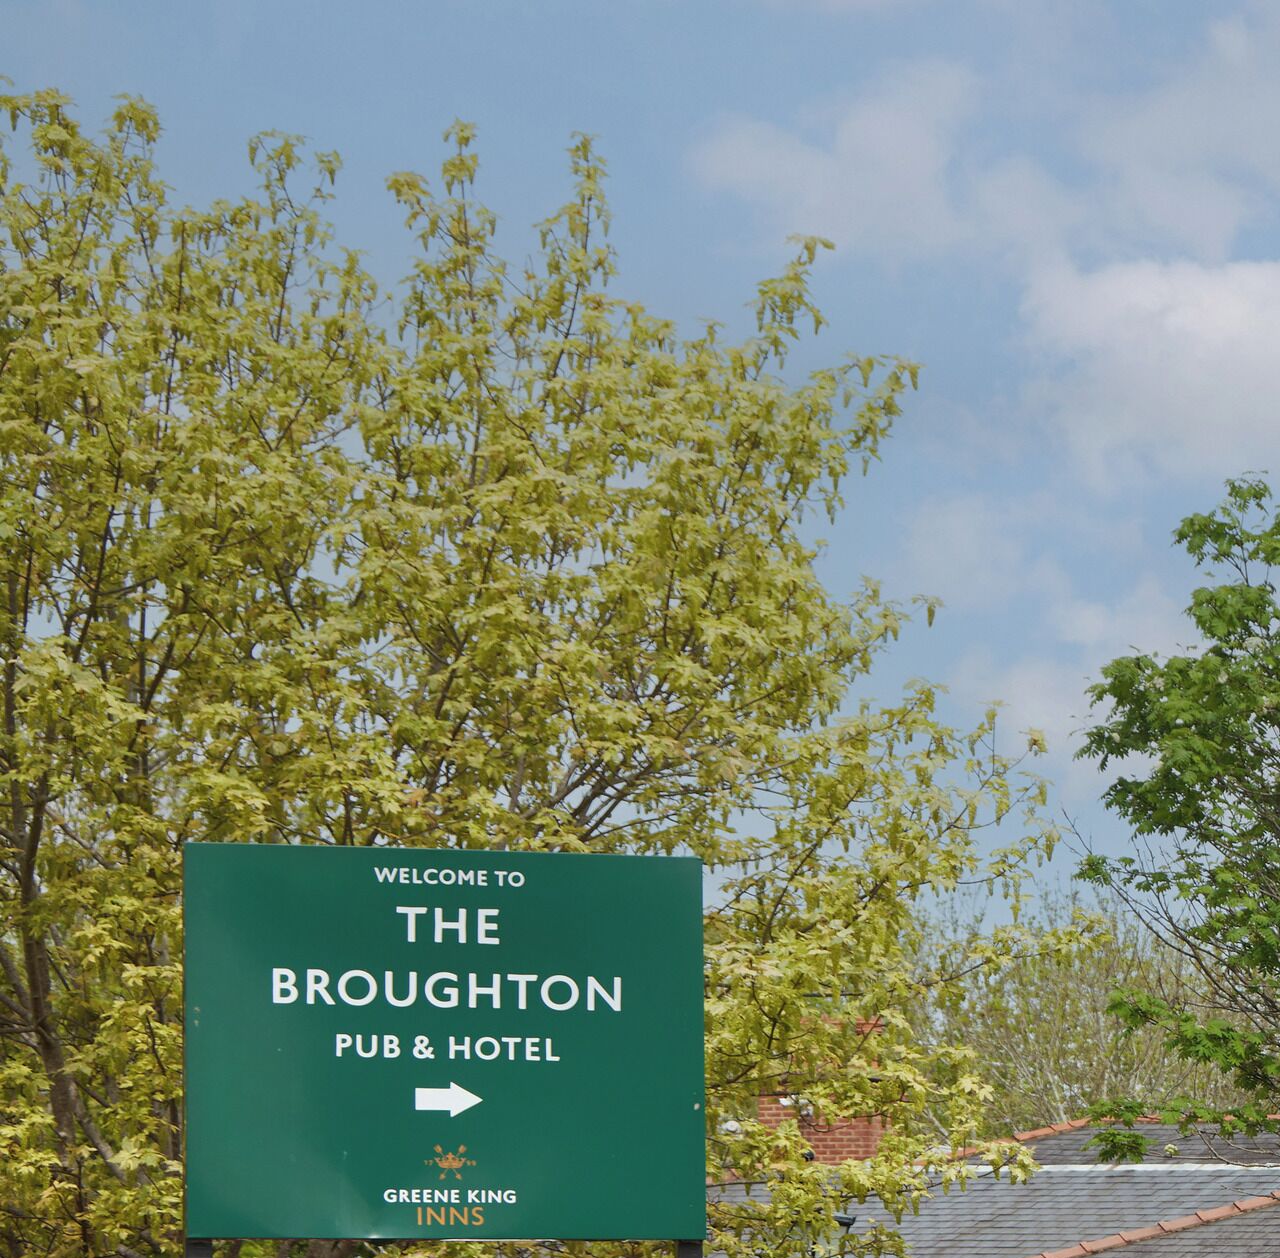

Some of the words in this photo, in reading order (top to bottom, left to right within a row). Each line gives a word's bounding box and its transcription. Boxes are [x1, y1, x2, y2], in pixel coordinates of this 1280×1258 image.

[374, 867, 488, 886] WELCOME
[494, 870, 526, 888] TO
[395, 906, 501, 945] THE
[271, 967, 623, 1013] BROUGHTON
[335, 1033, 401, 1059] PUB
[412, 1035, 435, 1060] &
[448, 1036, 561, 1062] HOTEL
[383, 1188, 461, 1204] GREENE
[467, 1189, 517, 1204] KING
[417, 1206, 485, 1226] INNS
